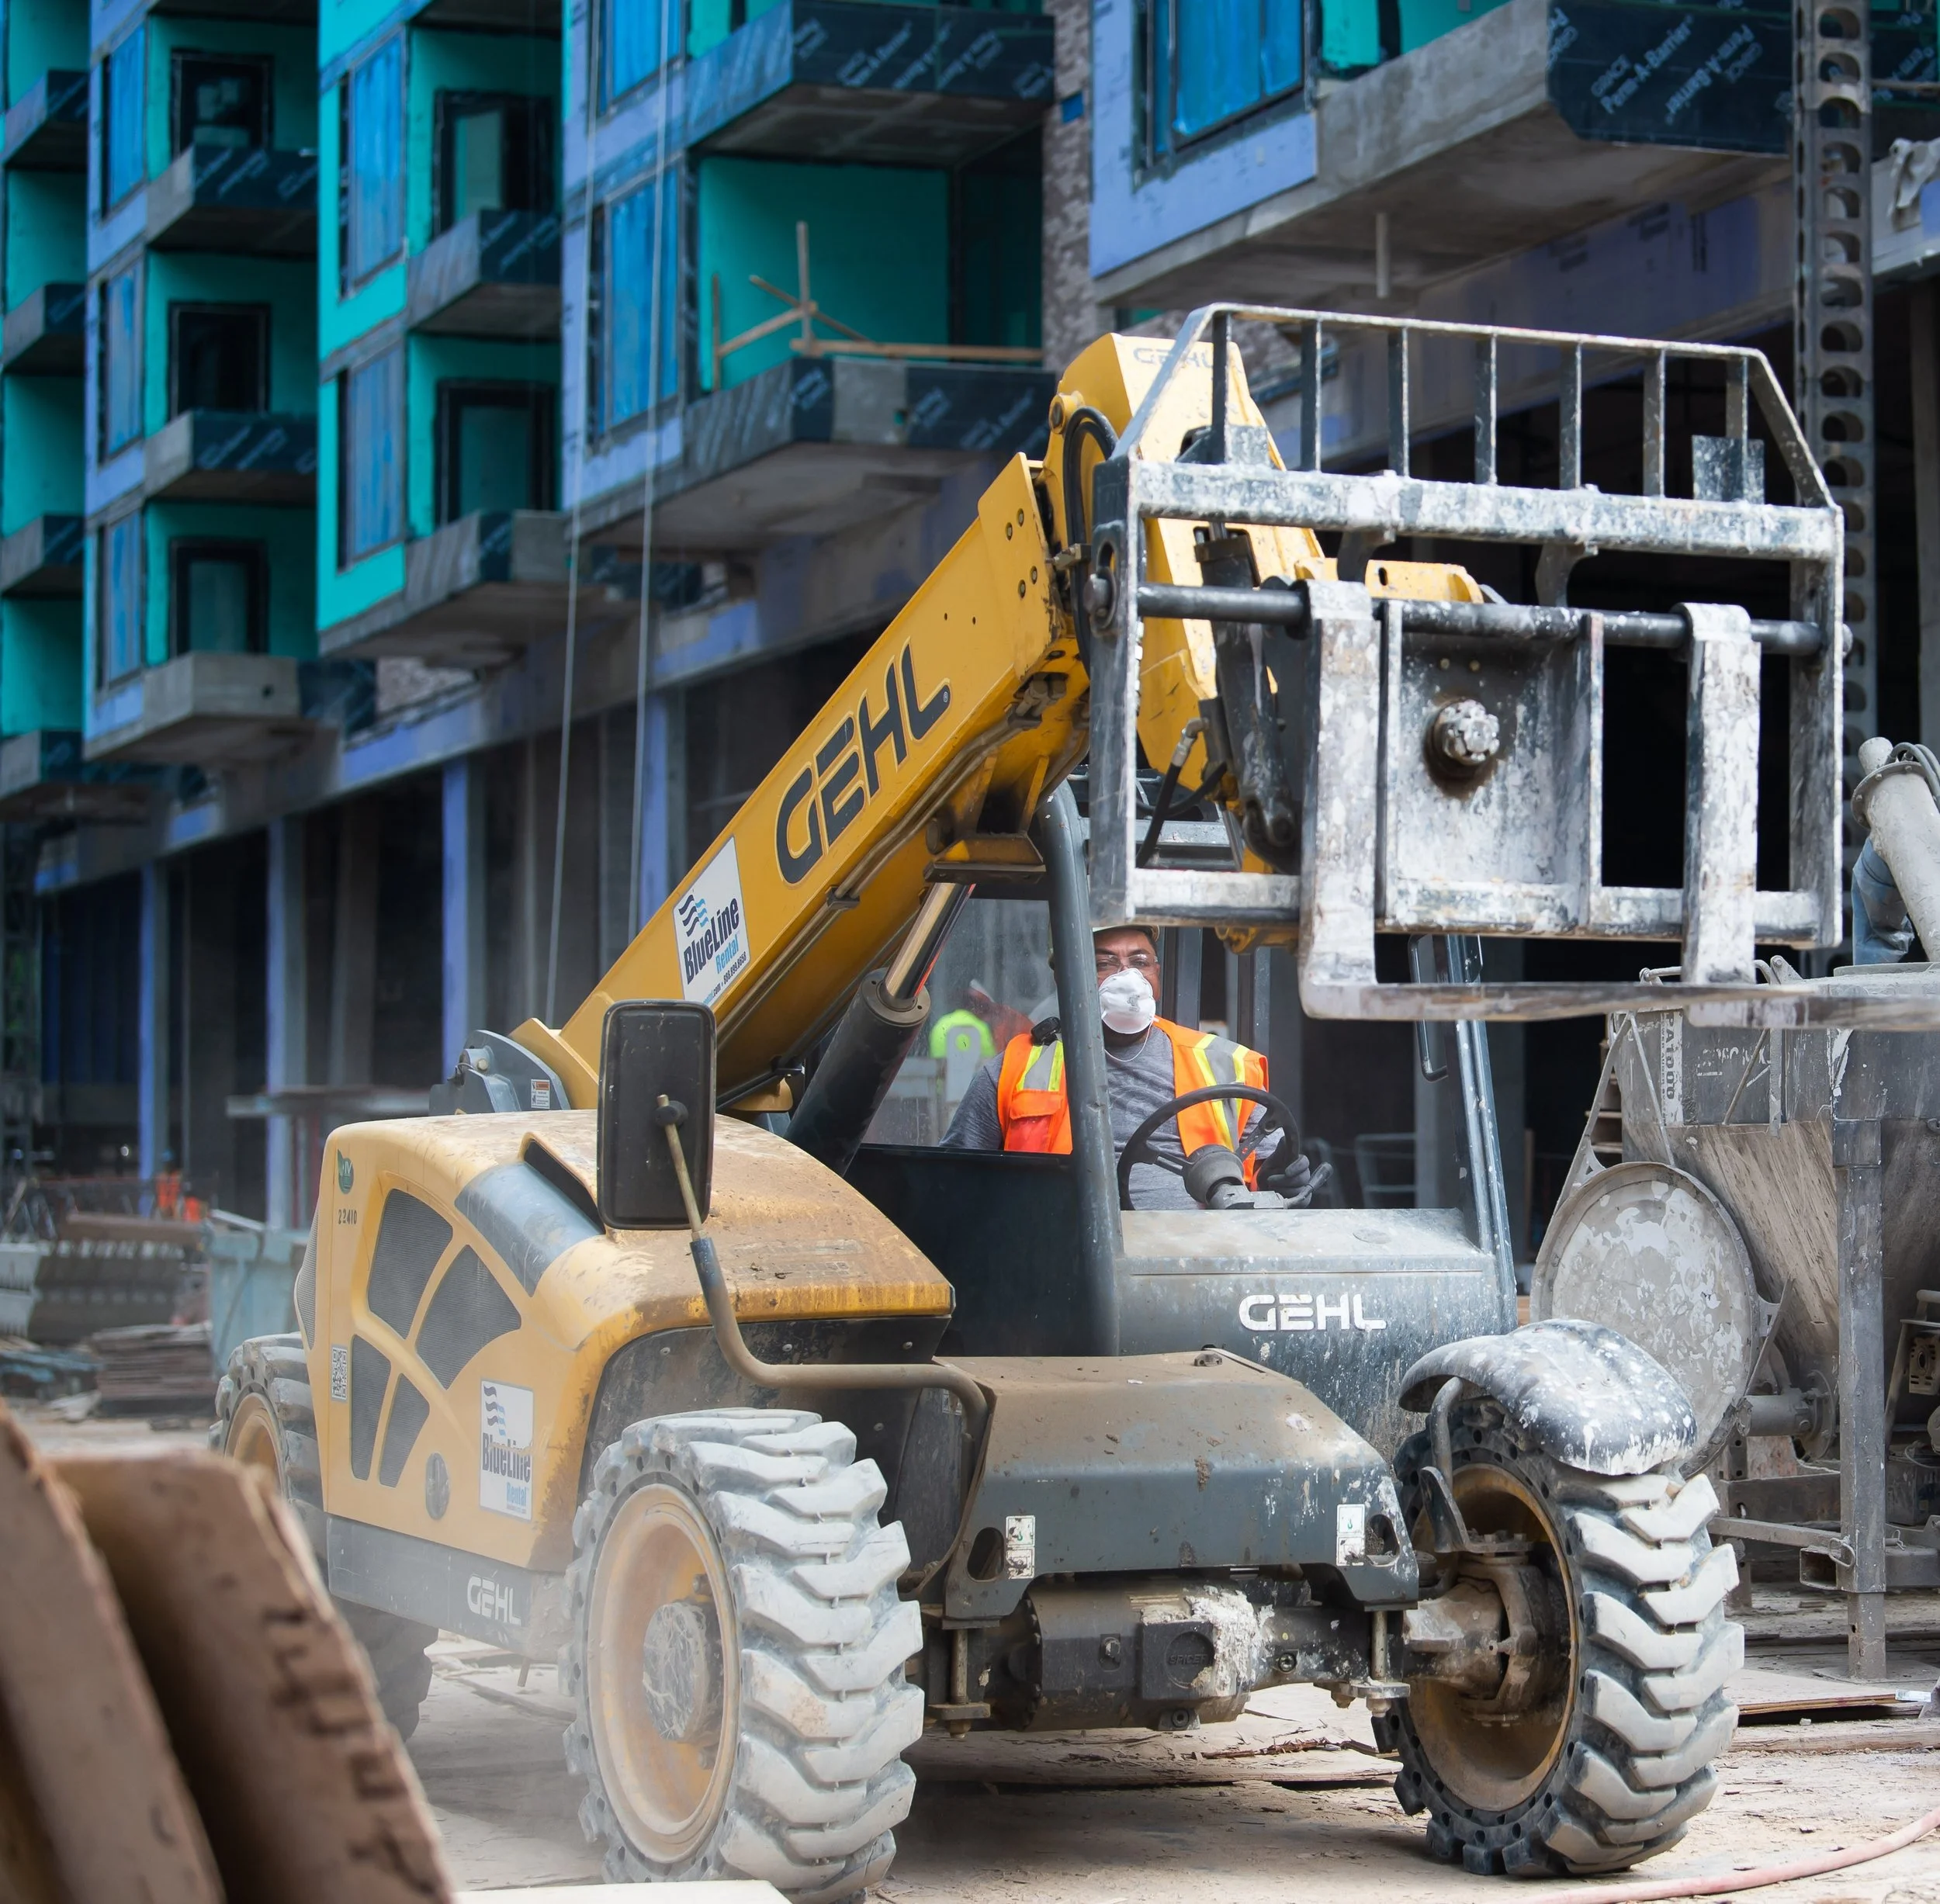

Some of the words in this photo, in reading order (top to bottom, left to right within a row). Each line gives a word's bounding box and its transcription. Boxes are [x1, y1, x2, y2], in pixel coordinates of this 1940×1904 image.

[776, 636, 951, 884] GEHL
[683, 898, 740, 985] BlueLine
[715, 935, 739, 975] Rental
[338, 1209, 358, 1225] 22410
[1238, 1292, 1387, 1331] GEHL
[482, 1431, 532, 1483] BlueLine
[506, 1482, 527, 1507] Rental
[467, 1573, 522, 1626] GEHL
